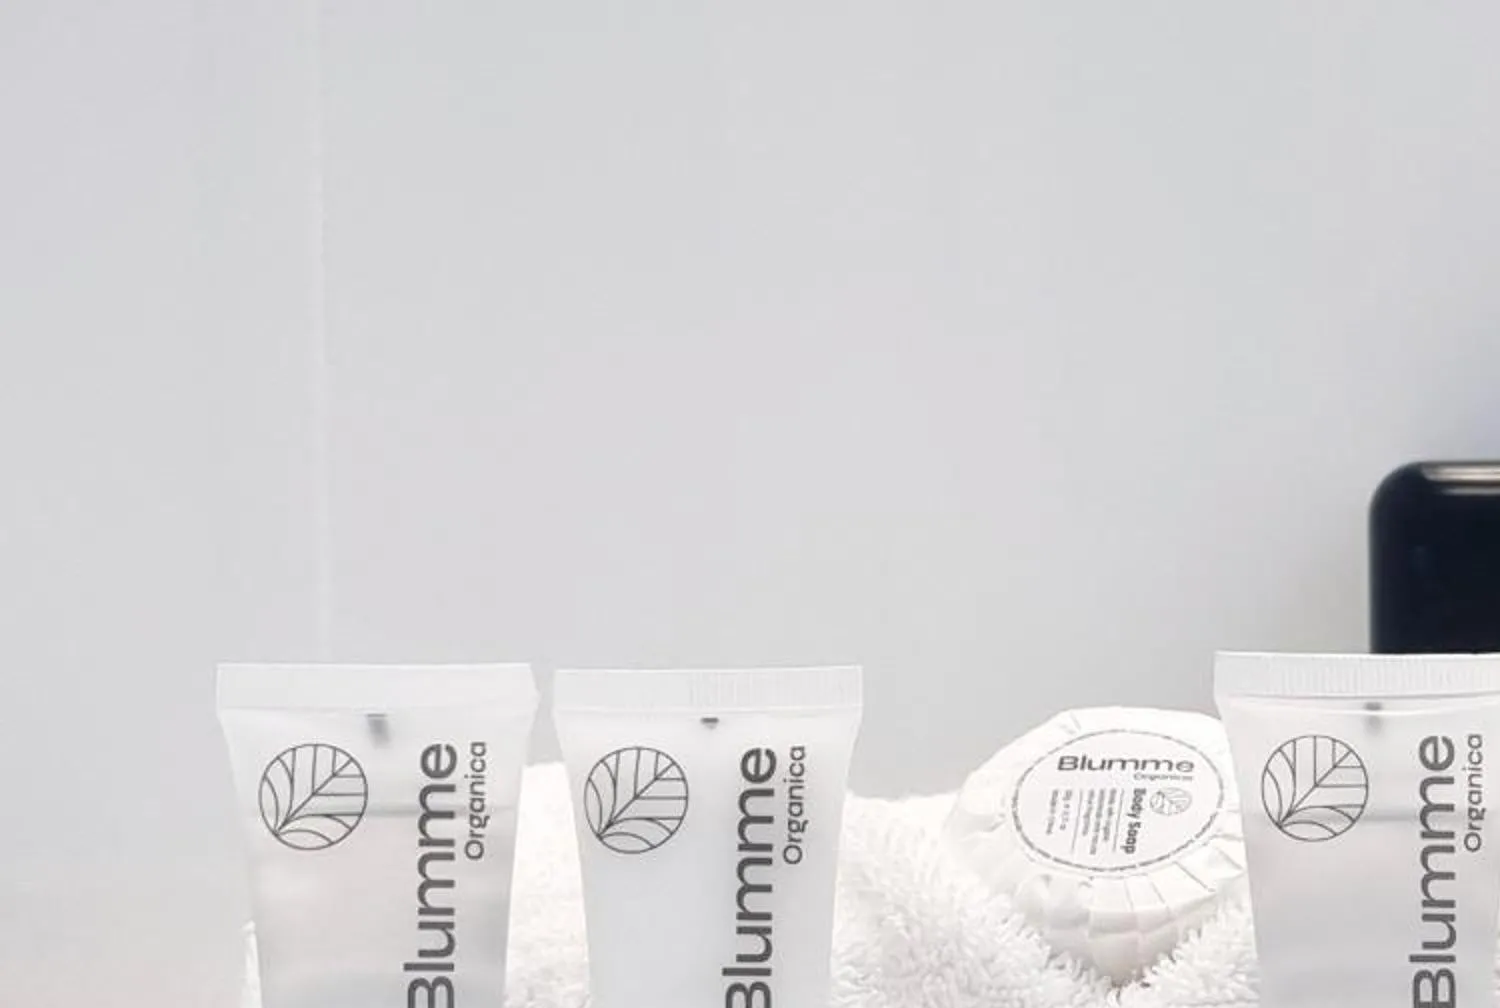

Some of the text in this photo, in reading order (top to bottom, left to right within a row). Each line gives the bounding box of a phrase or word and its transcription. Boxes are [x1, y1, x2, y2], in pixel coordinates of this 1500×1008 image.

[465, 741, 489, 861] Organica
[782, 745, 807, 865] Organica
[1057, 754, 1194, 772] Blumme
[1121, 788, 1146, 854] Body Soap
[1463, 732, 1485, 853] Organica
